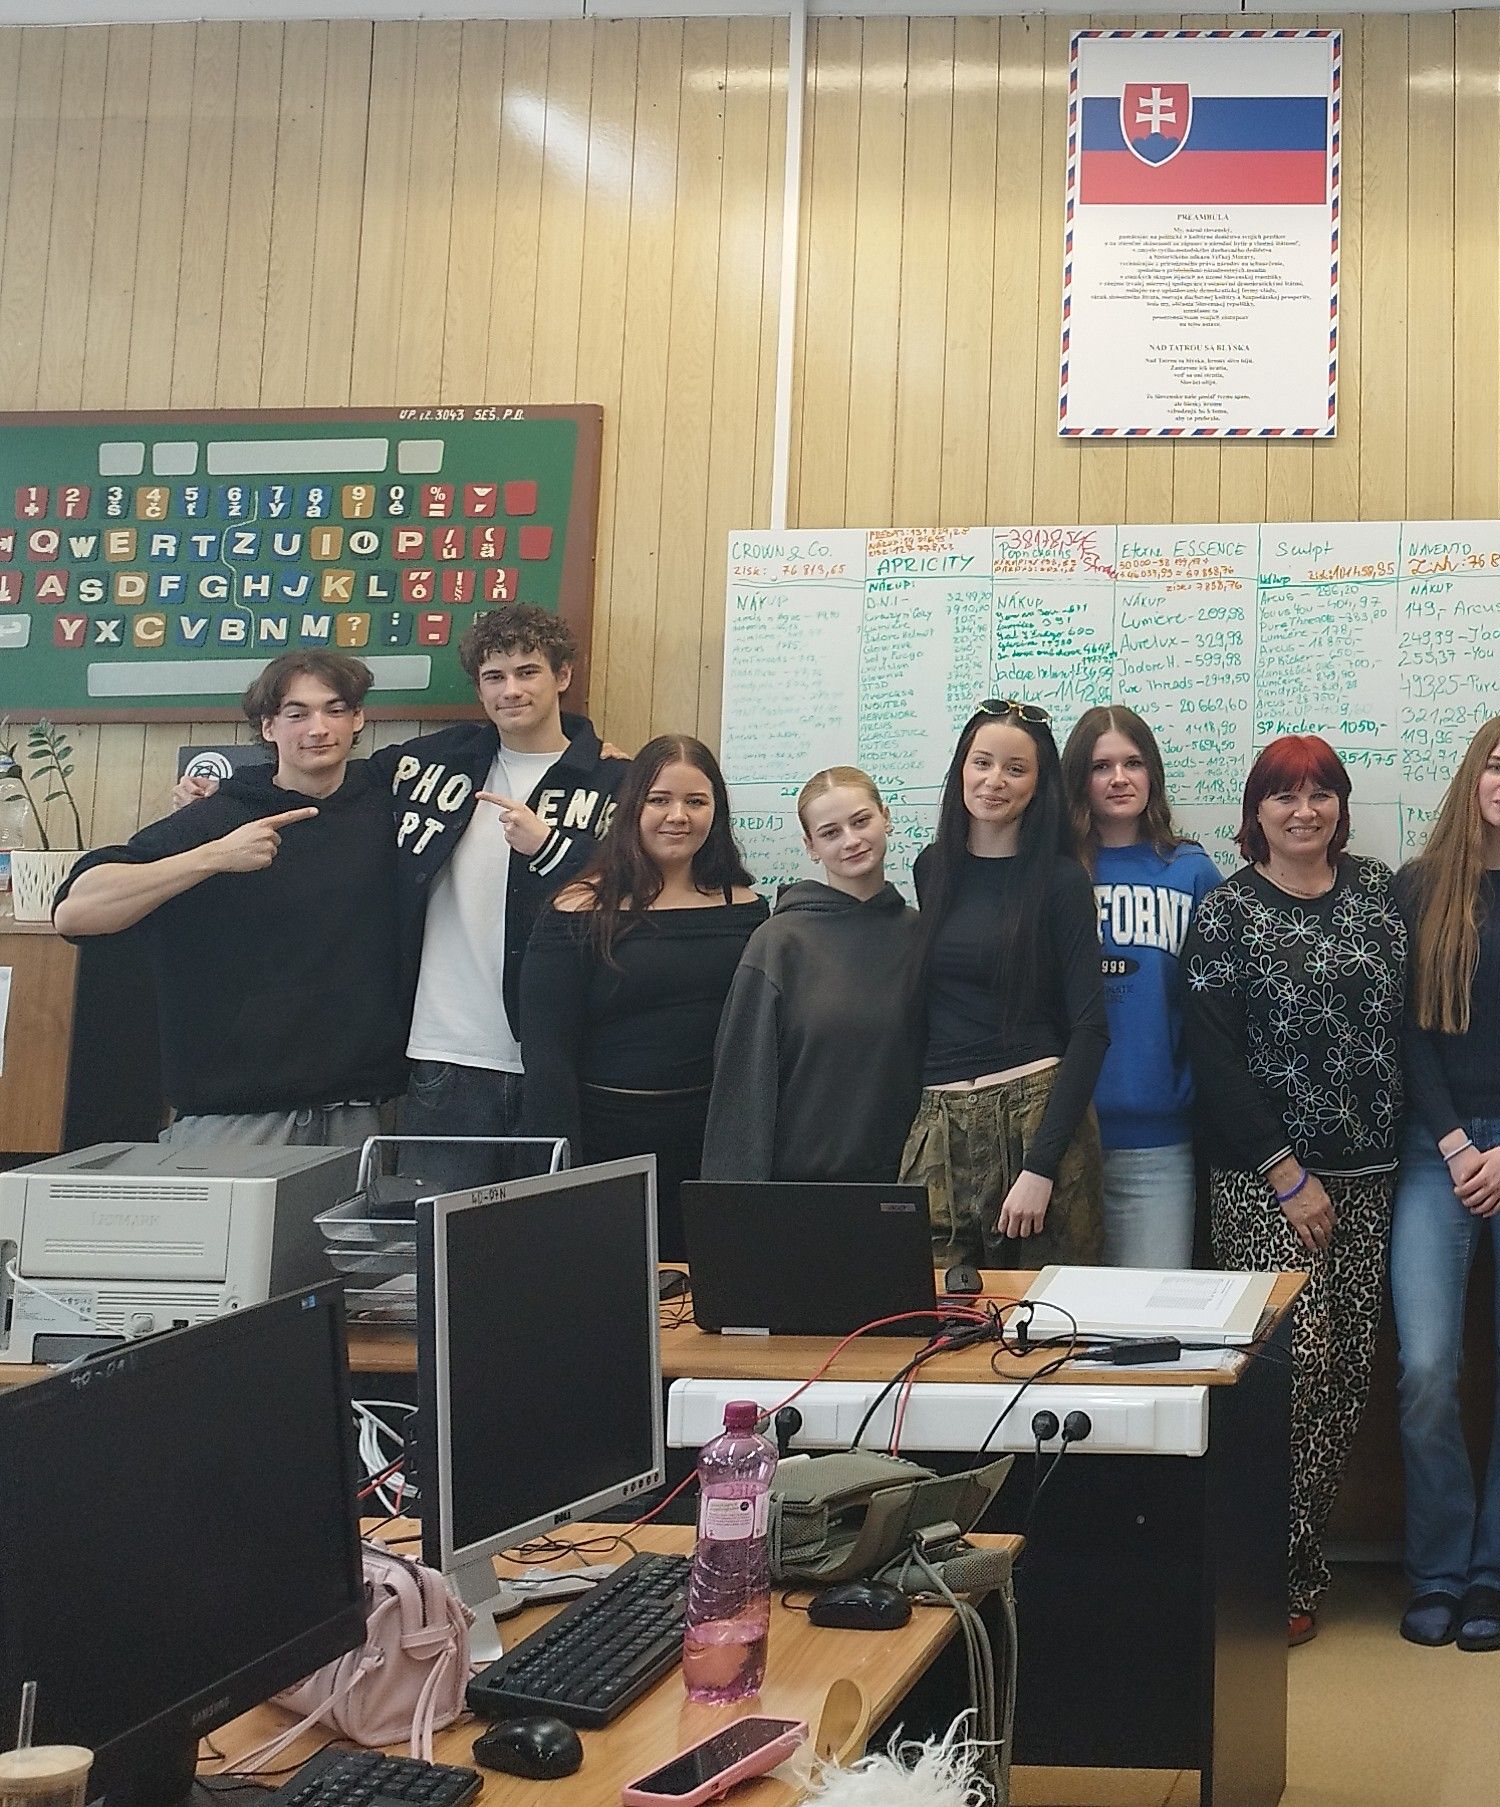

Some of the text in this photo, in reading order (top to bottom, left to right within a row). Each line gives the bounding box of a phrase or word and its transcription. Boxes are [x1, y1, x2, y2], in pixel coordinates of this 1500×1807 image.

[1149, 344, 1168, 352] NAD
[435, 408, 465, 421] 3043
[65, 488, 81, 502] 2
[107, 486, 123, 501] 3
[146, 488, 161, 501] 4
[184, 486, 199, 501] 5
[227, 487, 242, 501] 6
[271, 486, 284, 503] 7
[308, 488, 323, 503] 8
[352, 486, 366, 500] 9
[29, 530, 423, 558] Q W E R T Z U I O P
[732, 541, 785, 560] CROWN
[1173, 539, 1247, 557] ESSENCE
[876, 554, 975, 576] APRICITY
[36, 575, 388, 602] A S D F G H J K L
[57, 614, 331, 643] Y X C V B N M
[391, 754, 473, 812] PHO
[1092, 884, 1194, 959] FORNI
[1101, 960, 1126, 974] 999
